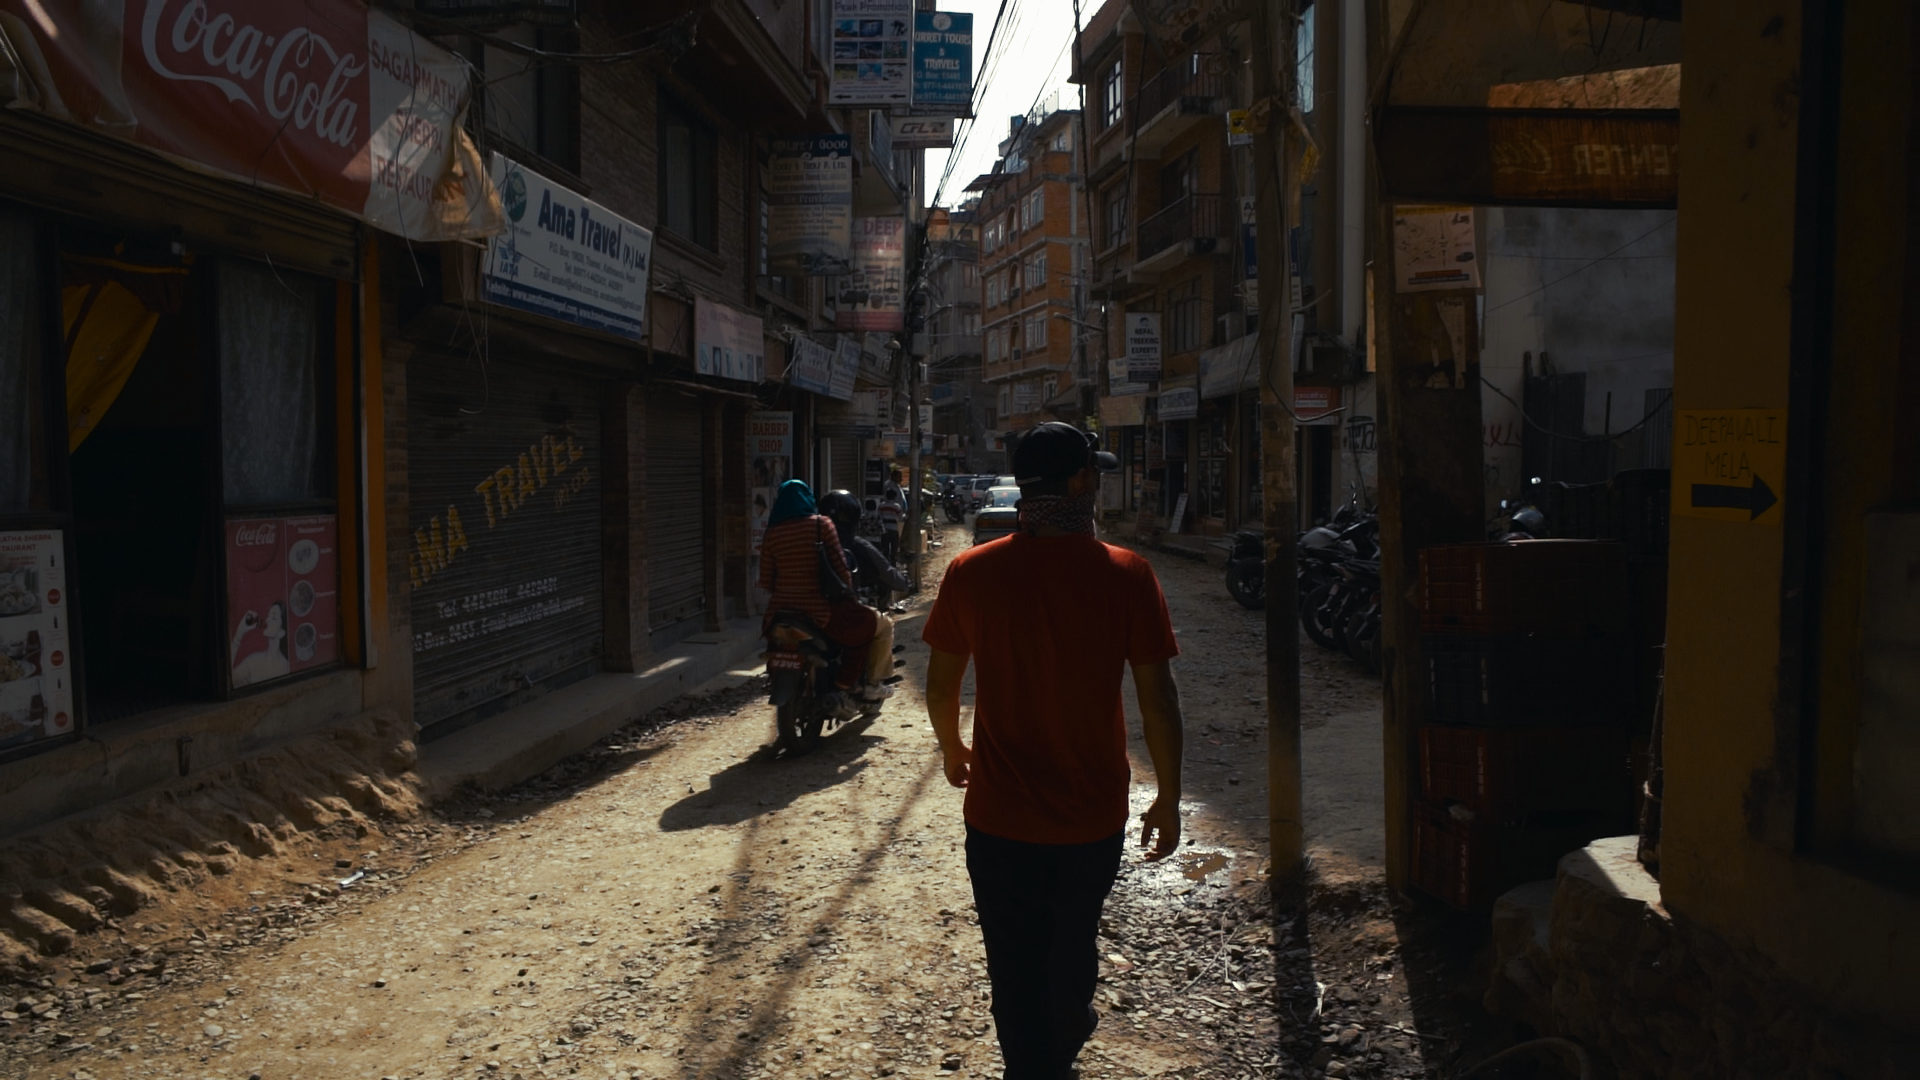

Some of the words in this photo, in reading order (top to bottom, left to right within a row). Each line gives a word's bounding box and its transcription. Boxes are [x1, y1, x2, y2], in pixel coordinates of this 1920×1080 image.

[924, 58, 960, 70] TRAVELS
[819, 138, 848, 150] GOOD
[537, 188, 576, 241] Ama
[579, 206, 622, 260] Travel
[863, 219, 902, 235] DEEP
[499, 261, 519, 278] IATA
[752, 422, 789, 436] BARBER
[1683, 414, 1780, 446] DEEPAVALI
[758, 439, 783, 453] SHOP
[1704, 450, 1751, 480] MELA
[474, 434, 585, 529] TRAVEL
[24, 534, 53, 542] SHERPA
